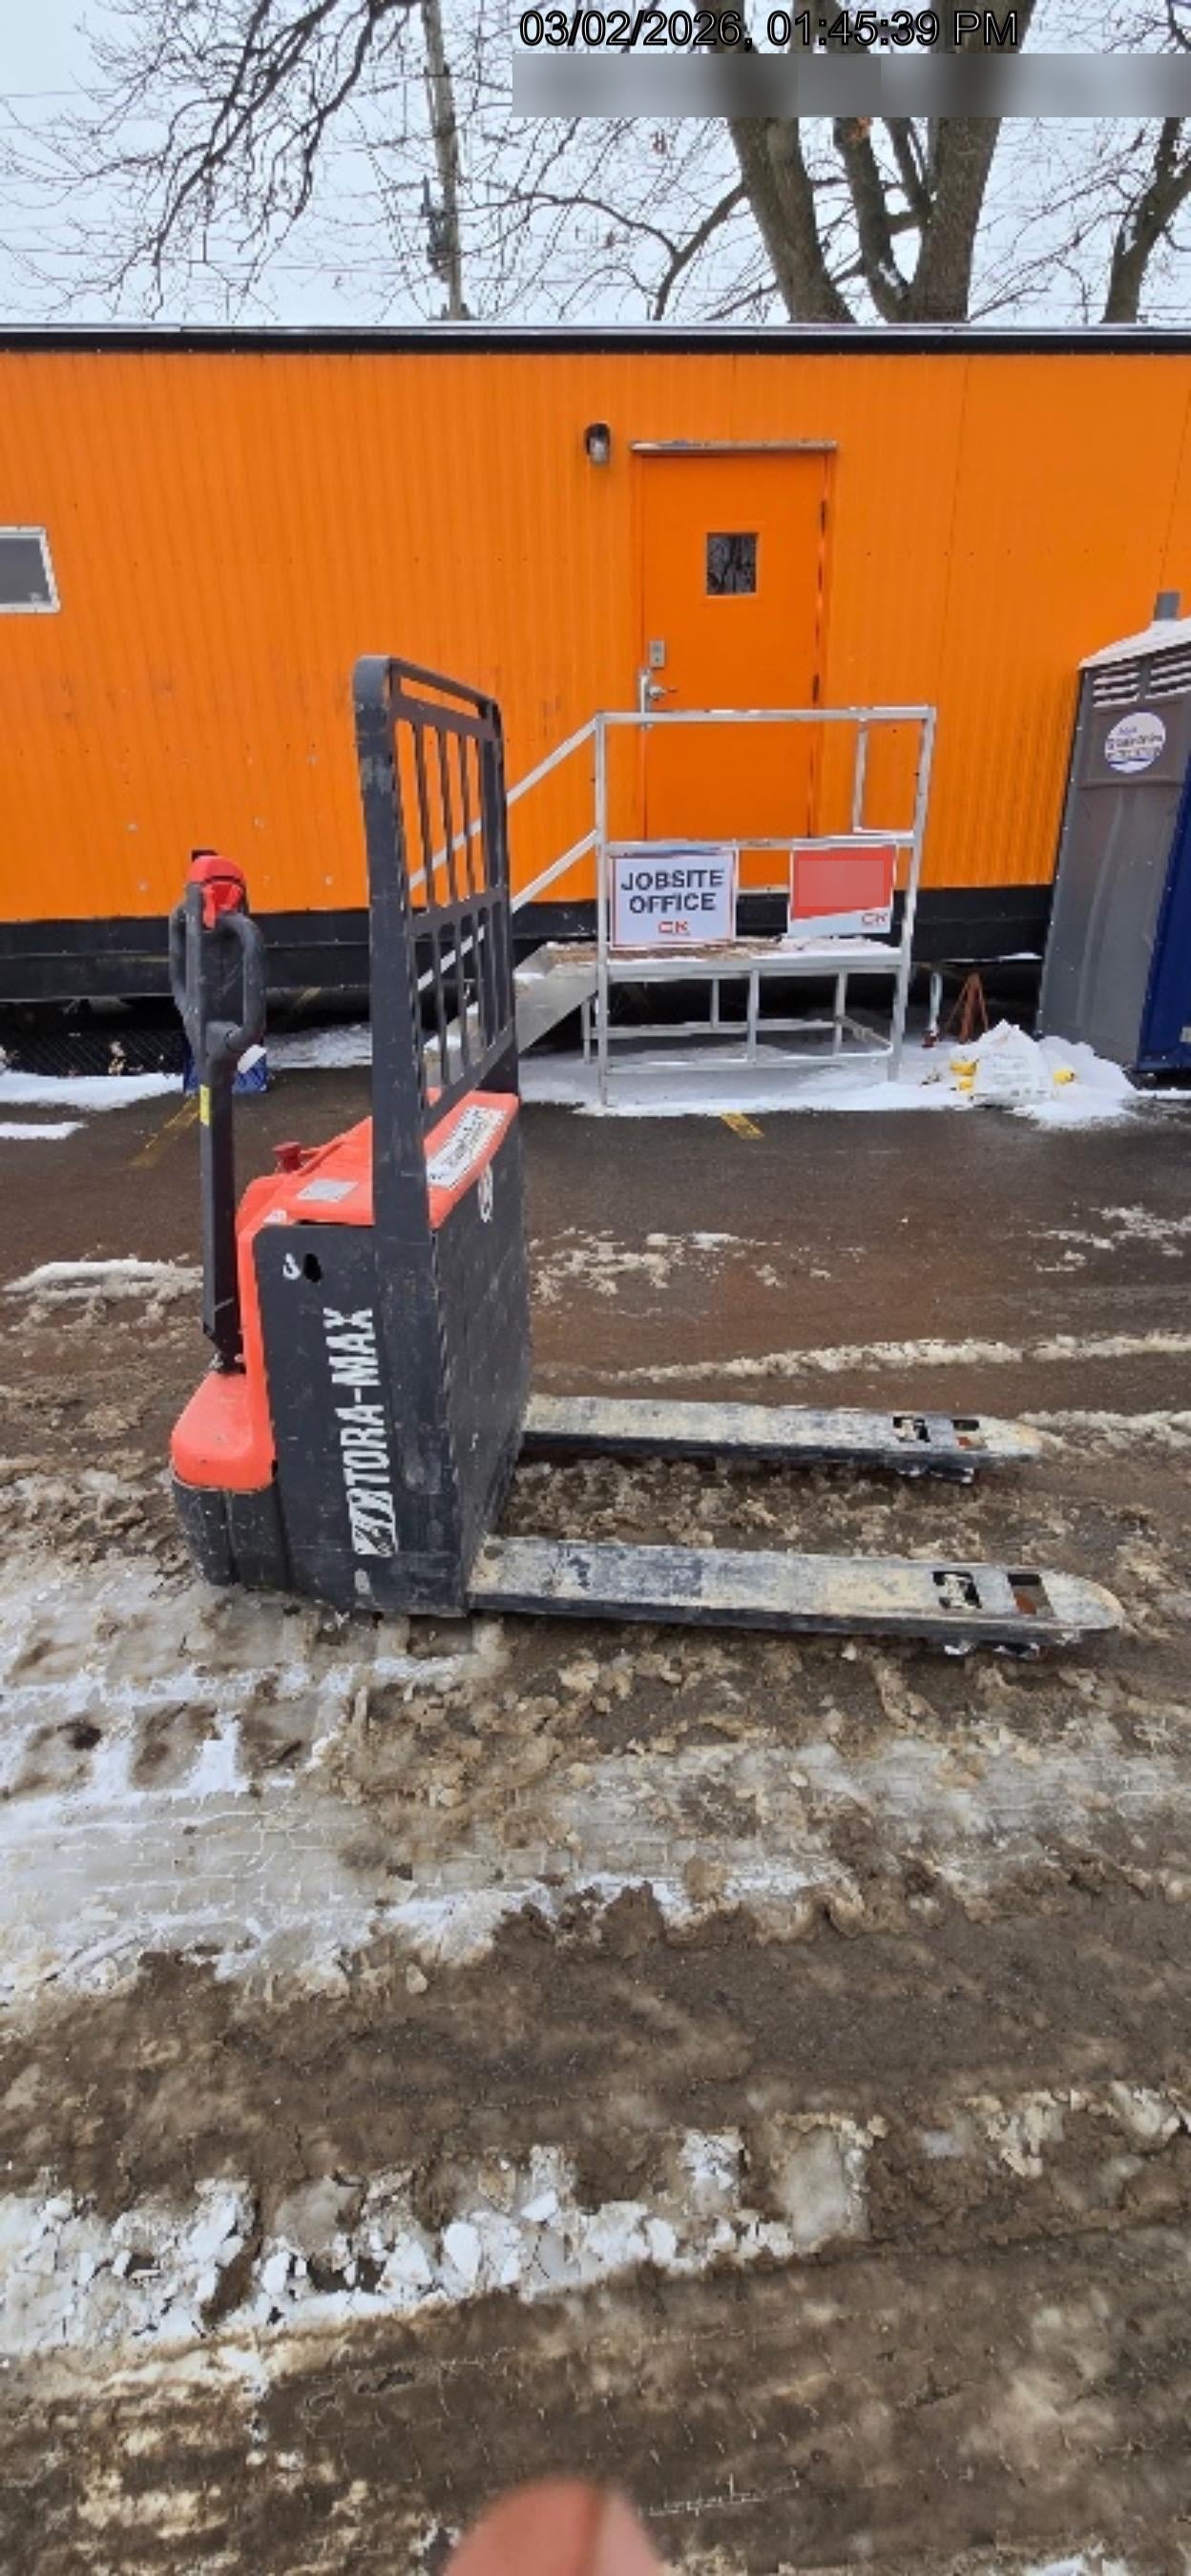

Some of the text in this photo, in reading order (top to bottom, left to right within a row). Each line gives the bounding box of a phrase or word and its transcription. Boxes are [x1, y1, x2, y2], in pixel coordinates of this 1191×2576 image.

[620, 869, 724, 891] JOBSITE
[629, 892, 717, 914] OFFICE
[323, 1306, 390, 1487] TORA-MAX
